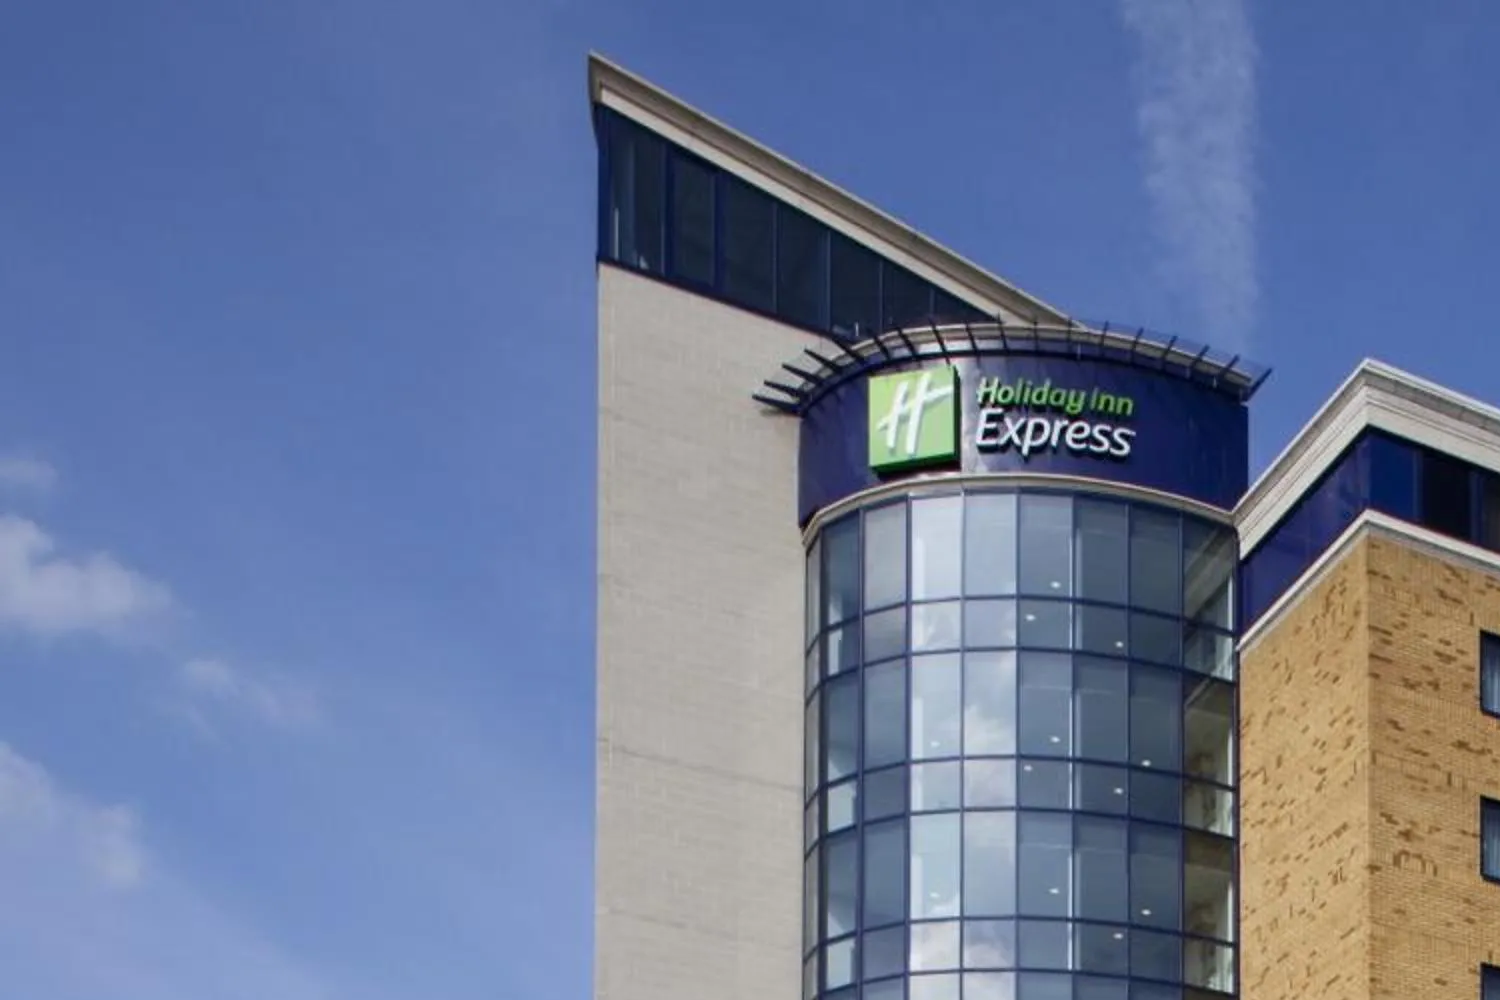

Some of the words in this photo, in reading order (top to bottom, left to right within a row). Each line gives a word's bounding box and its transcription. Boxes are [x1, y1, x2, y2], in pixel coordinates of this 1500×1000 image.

[976, 376, 1087, 416] Holiday
[1090, 387, 1135, 417] Inn
[975, 407, 1137, 457] Express
